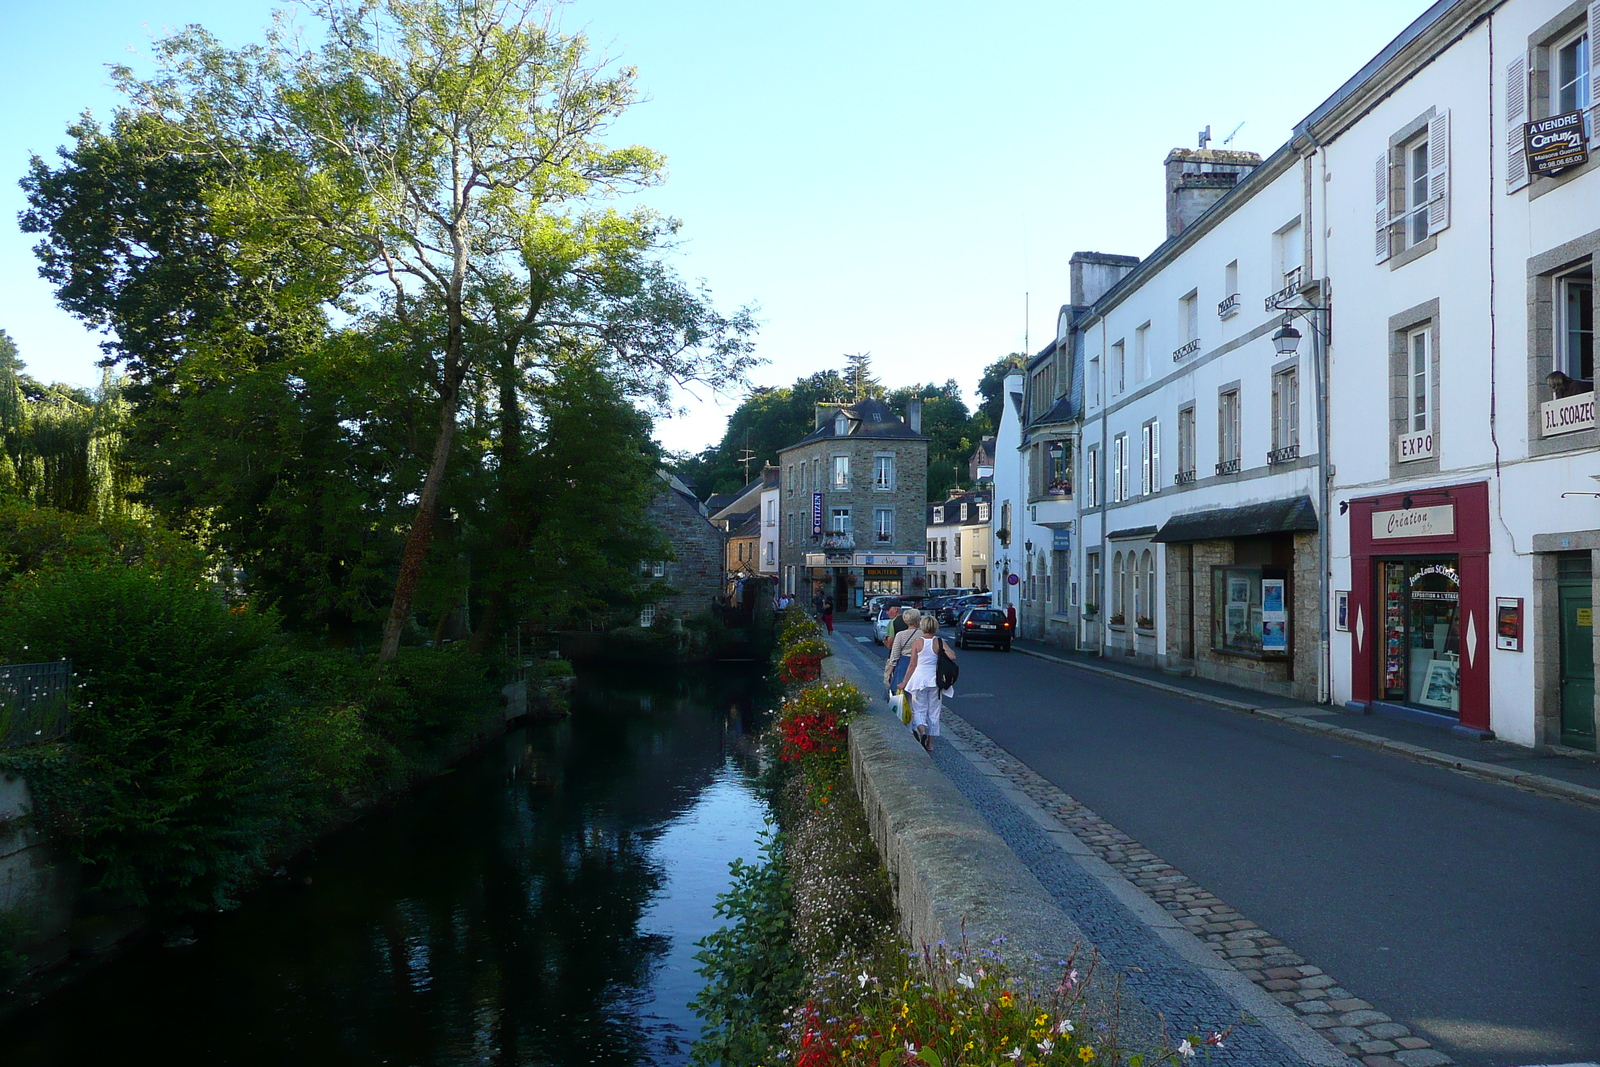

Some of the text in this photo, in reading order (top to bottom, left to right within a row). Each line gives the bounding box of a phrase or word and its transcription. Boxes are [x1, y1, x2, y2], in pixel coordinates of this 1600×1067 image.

[1530, 114, 1578, 134] A VENDRE
[1531, 131, 1572, 148] Century
[1534, 152, 1559, 161] Maisons
[1402, 435, 1432, 456] EXPO
[1387, 513, 1428, 534] Création
